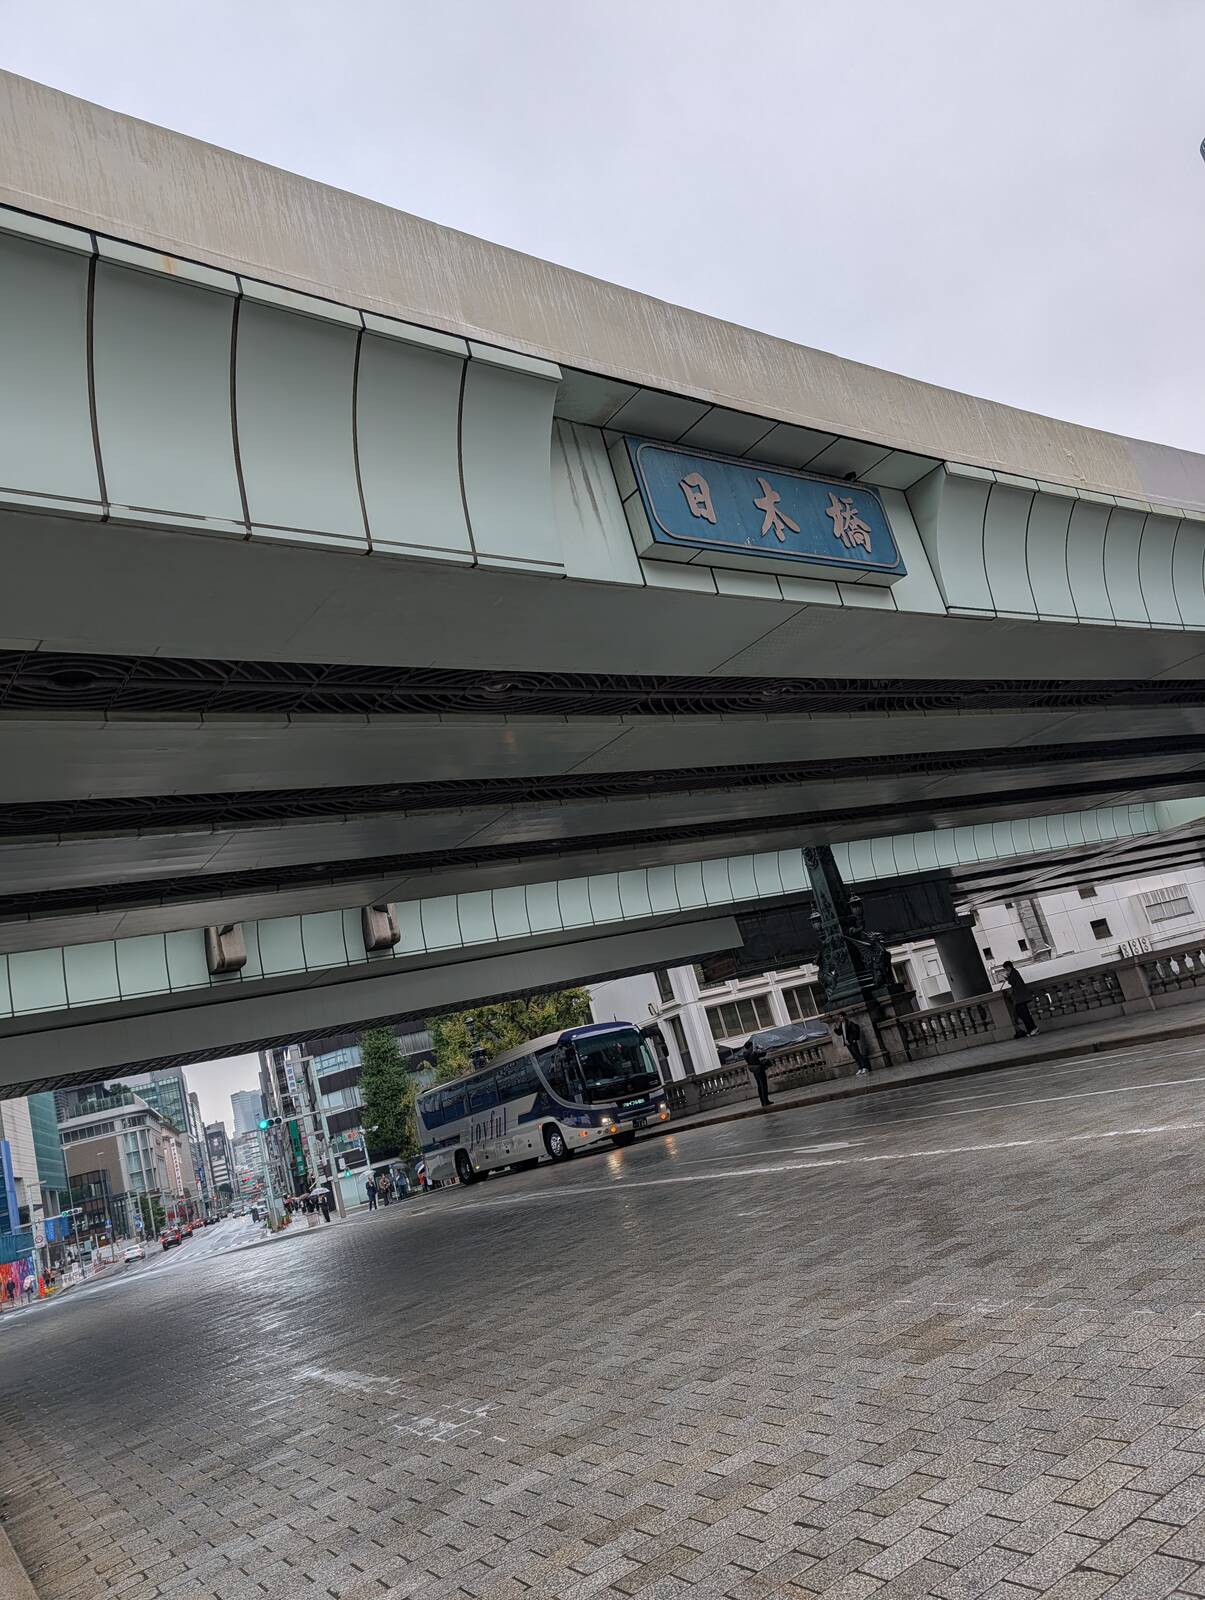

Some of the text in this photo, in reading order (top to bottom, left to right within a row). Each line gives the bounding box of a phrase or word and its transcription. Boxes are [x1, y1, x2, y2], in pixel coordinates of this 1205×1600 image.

[679, 472, 872, 553] 日本橋
[469, 1107, 507, 1154] joyful
